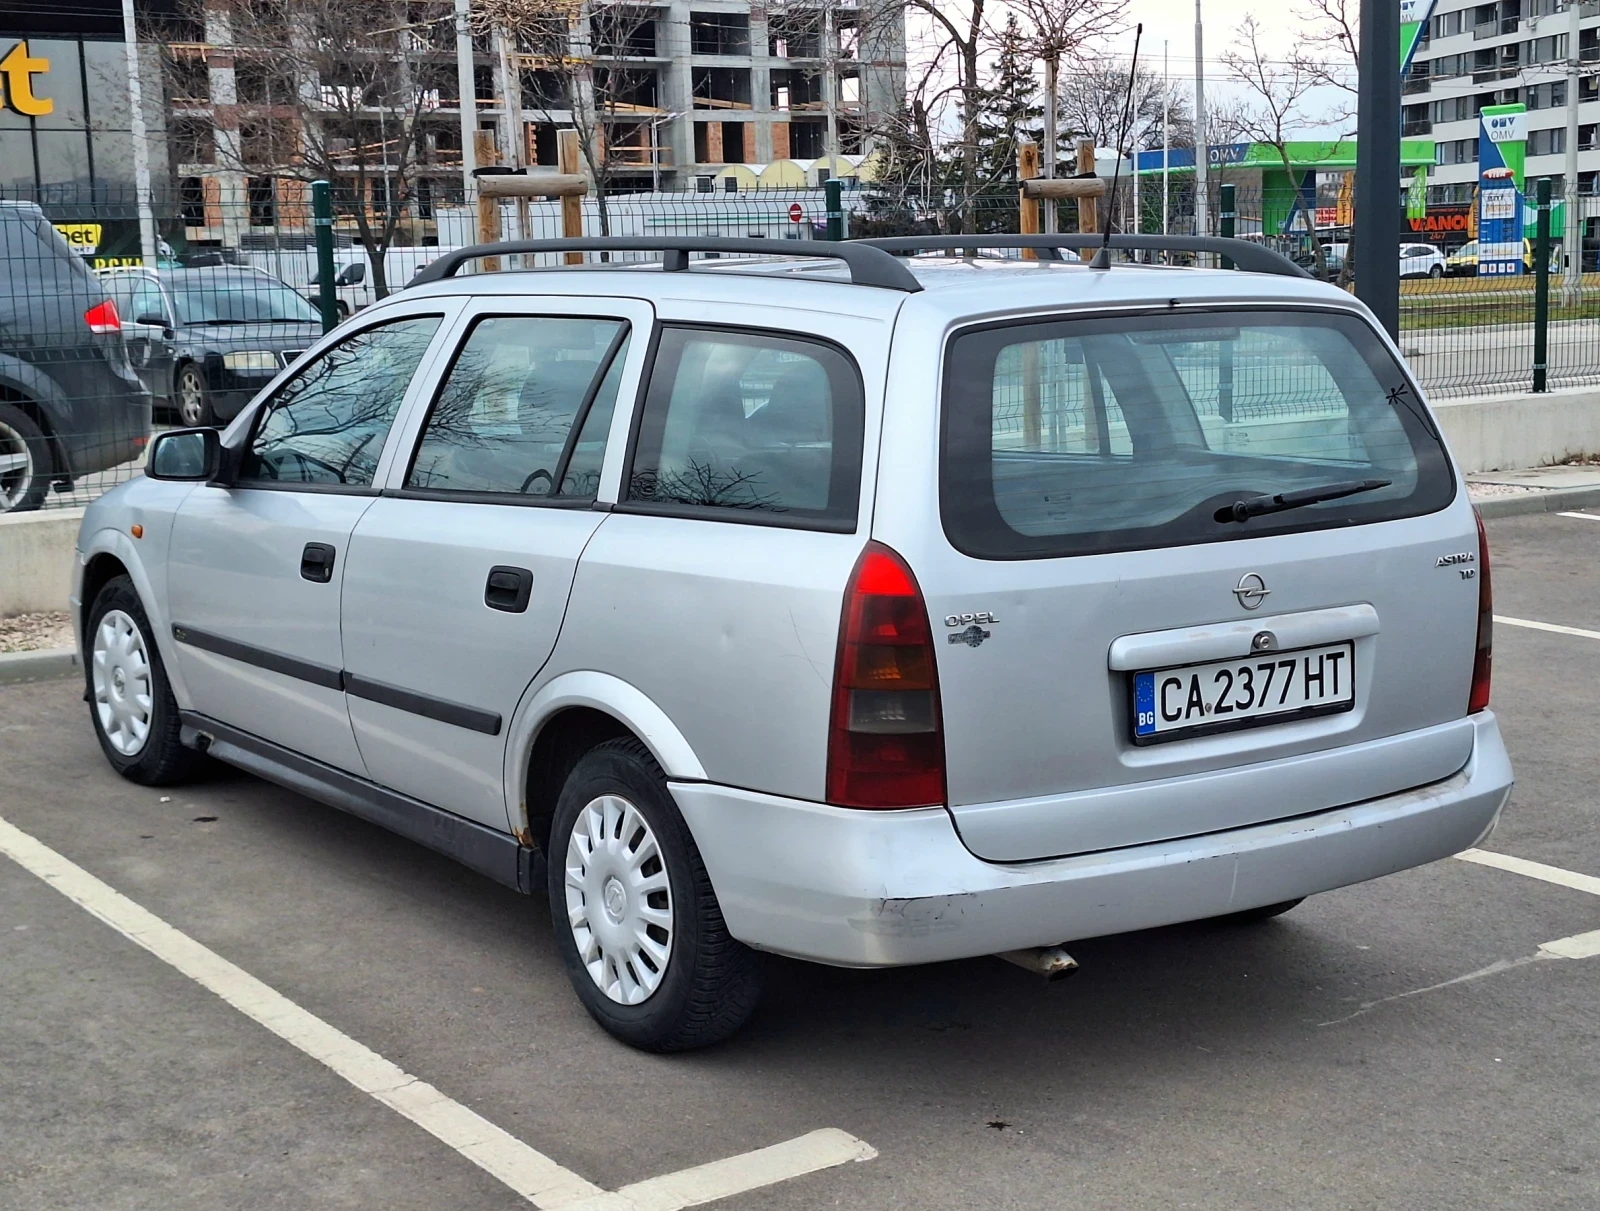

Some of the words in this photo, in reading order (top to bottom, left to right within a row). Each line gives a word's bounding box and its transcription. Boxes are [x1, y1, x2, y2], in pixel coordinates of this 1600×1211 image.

[1401, 13, 1415, 22] MV
[0, 40, 54, 115] t
[1490, 130, 1515, 140] OMV
[1209, 147, 1239, 162] OMV
[1434, 551, 1475, 568] ASTRA
[944, 611, 1000, 627] OPEL
[1213, 659, 1297, 715] 2377
[1138, 711, 1154, 727] BG
